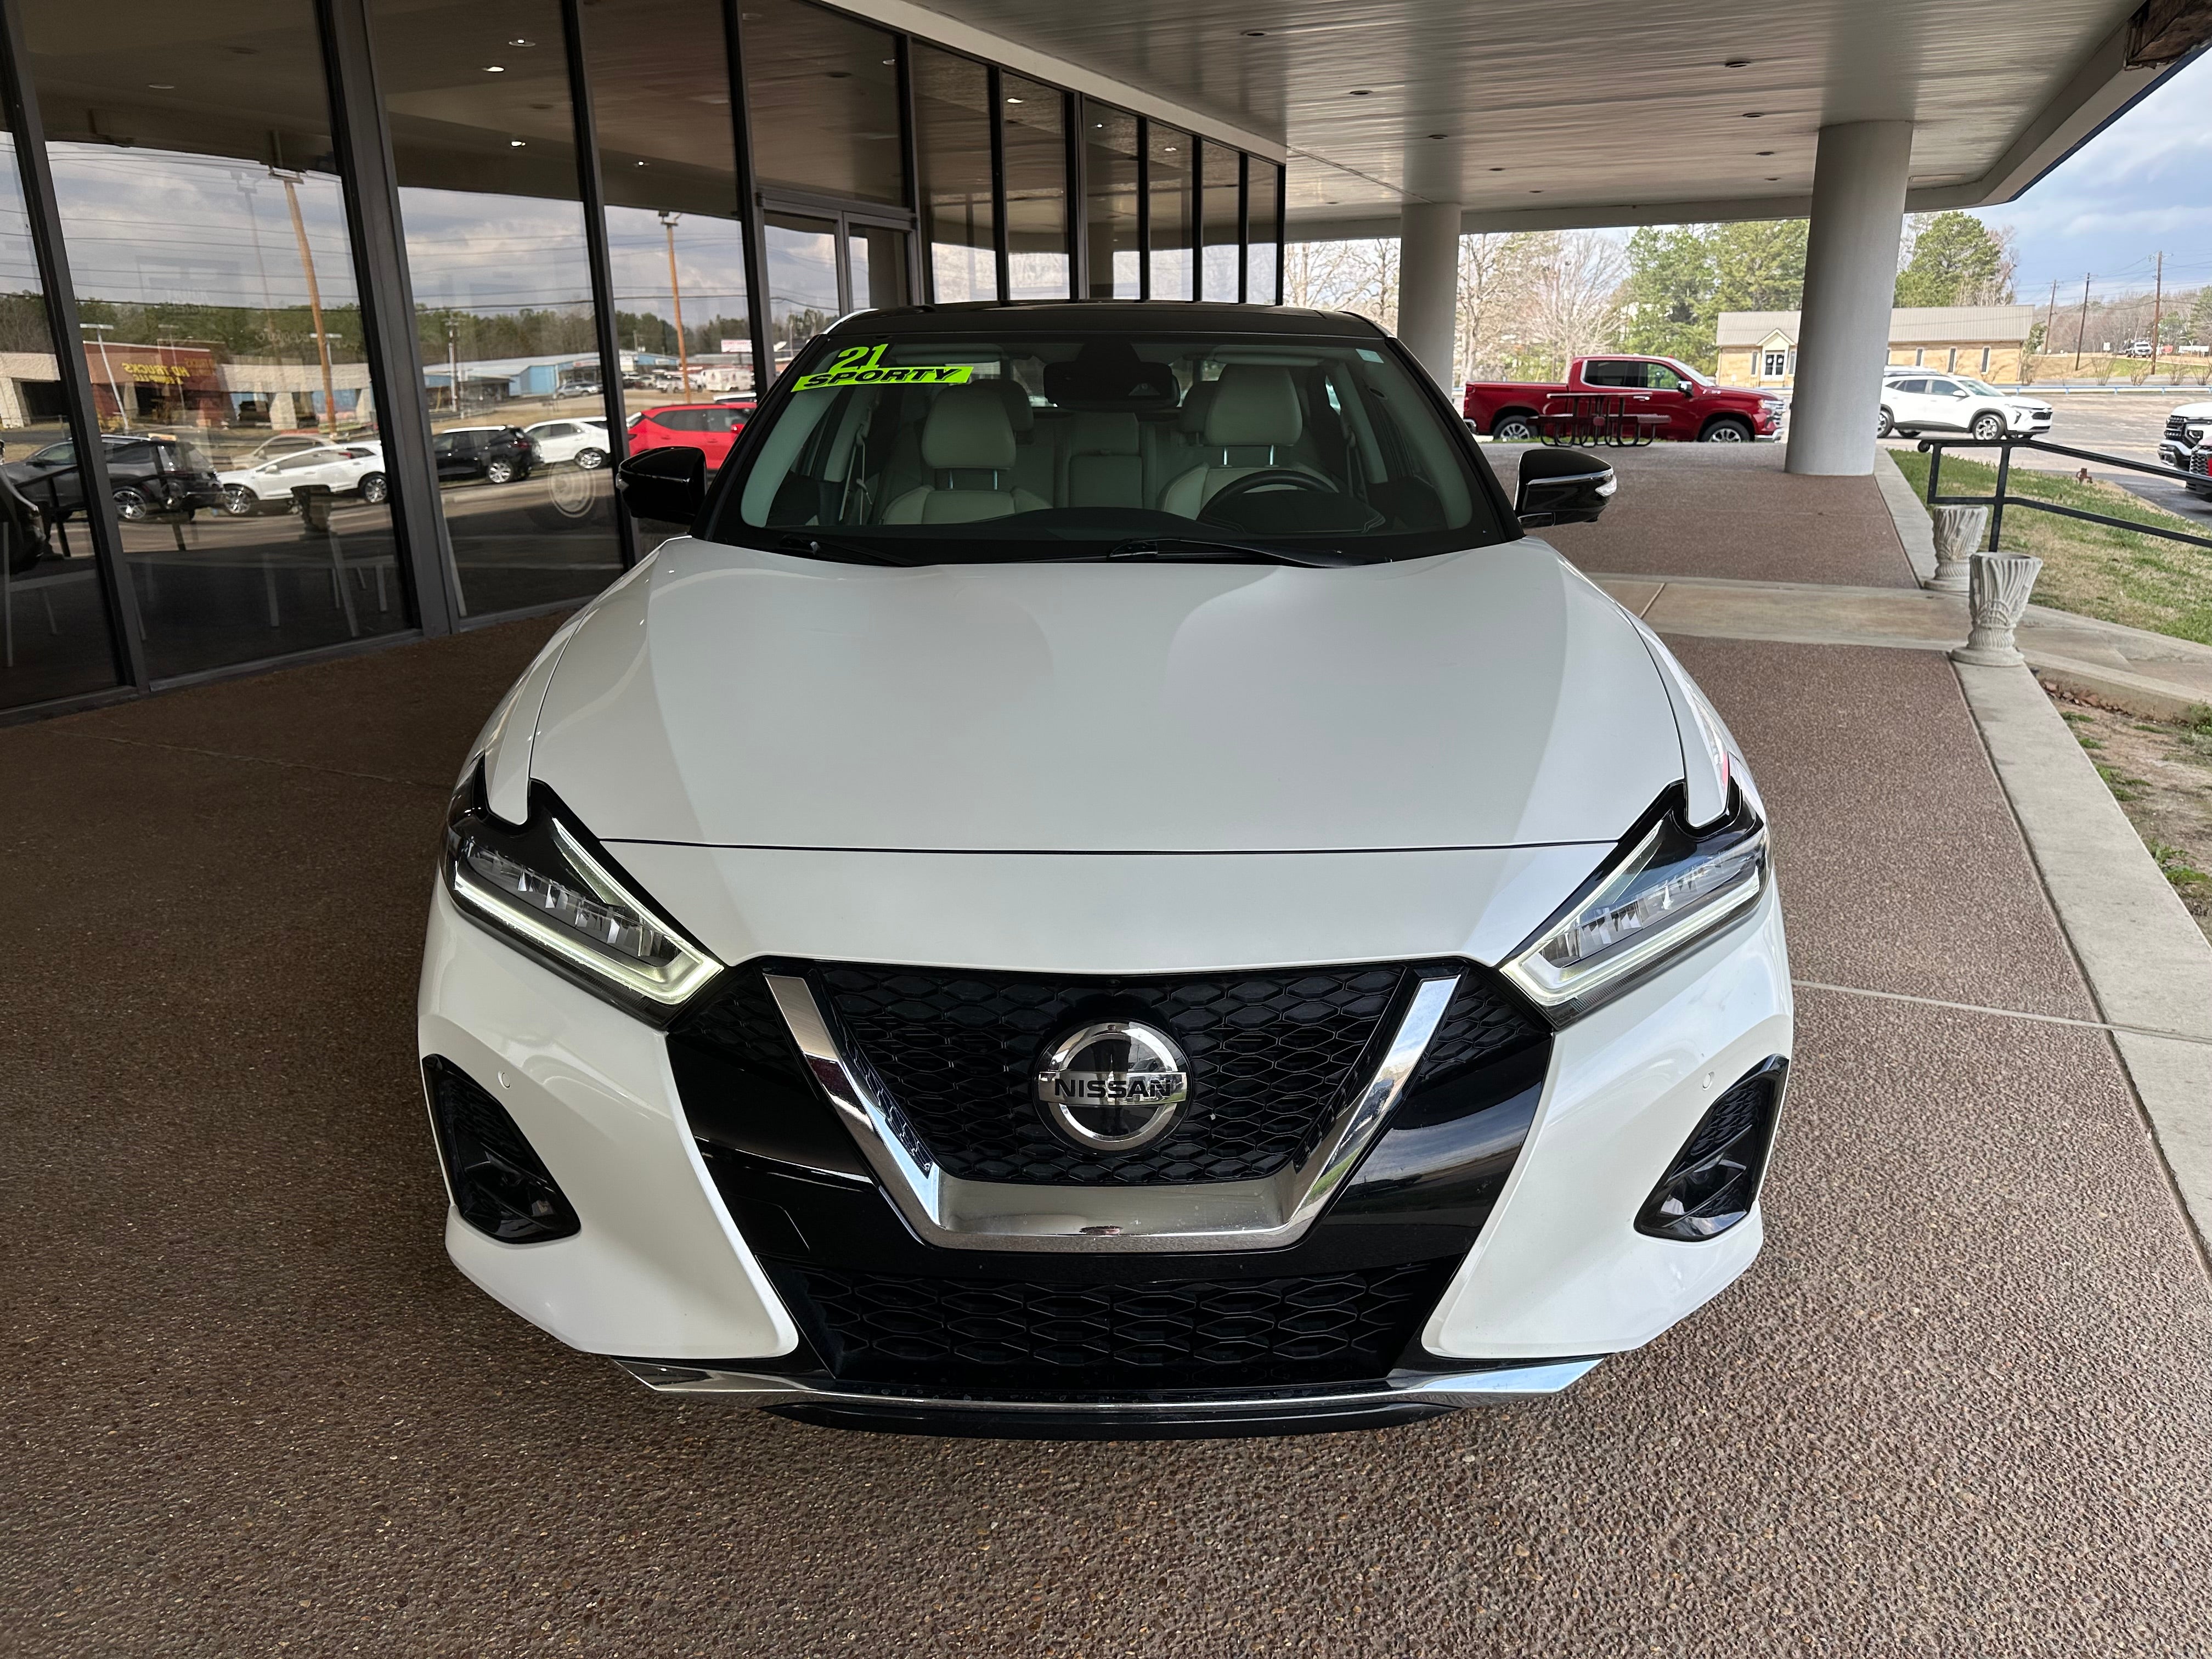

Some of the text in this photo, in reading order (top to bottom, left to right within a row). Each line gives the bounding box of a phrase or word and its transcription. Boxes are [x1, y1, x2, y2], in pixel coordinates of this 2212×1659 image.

[828, 343, 889, 374] 21
[804, 369, 962, 387] SPORTY
[1054, 1078, 1171, 1098] NISSAN
